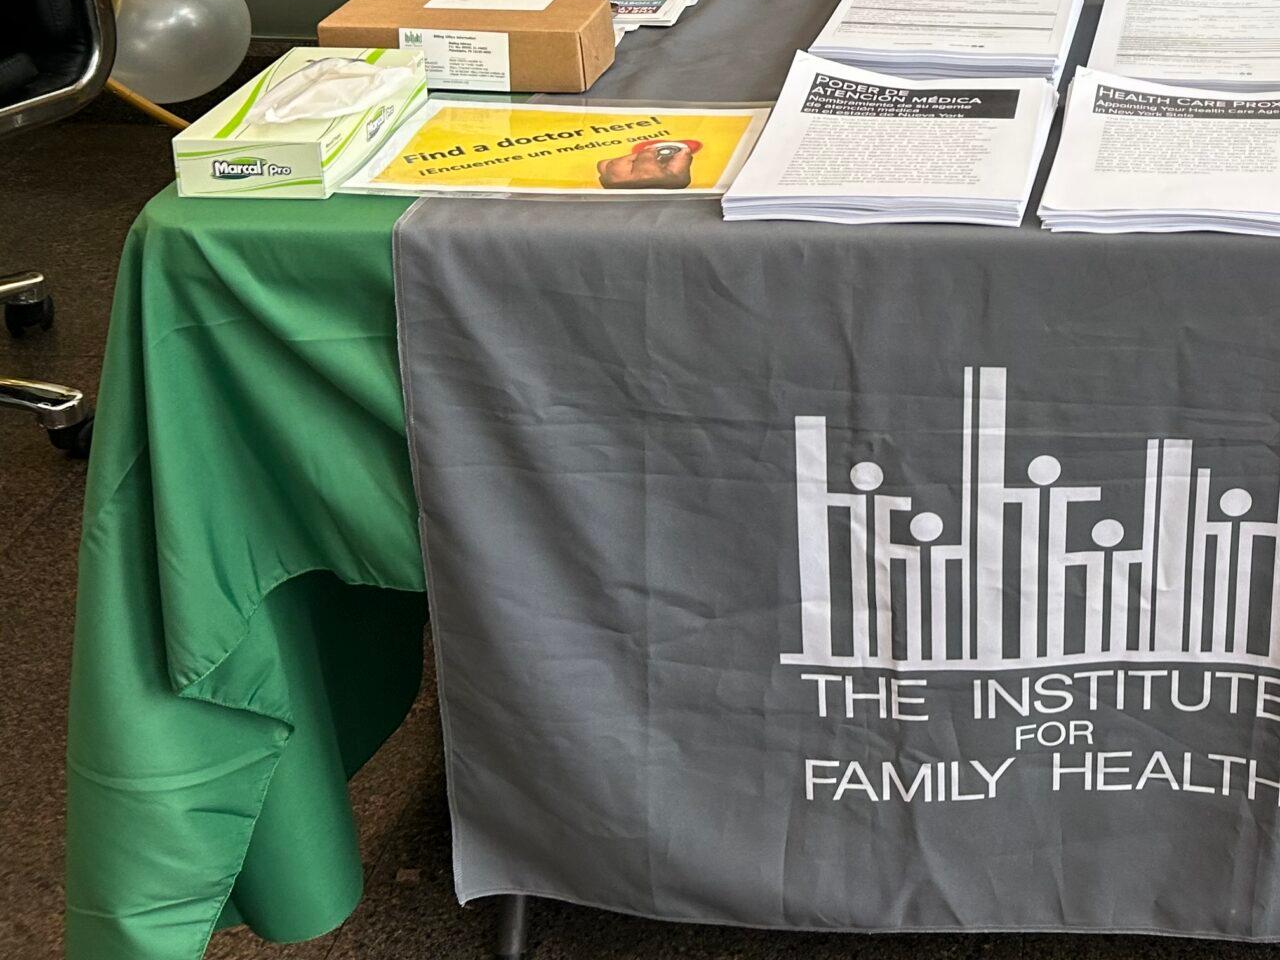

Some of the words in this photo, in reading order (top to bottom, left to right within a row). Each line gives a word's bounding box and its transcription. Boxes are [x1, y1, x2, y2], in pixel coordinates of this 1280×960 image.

[816, 75, 880, 94] PODER
[885, 88, 910, 96] DE
[808, 94, 894, 108] Nombramiento
[912, 96, 982, 104] MÉDICA
[1096, 99, 1158, 112] Appointing
[1188, 106, 1225, 114] Health
[1098, 86, 1170, 104] HEALTH
[1176, 98, 1226, 108] CARE
[1108, 108, 1134, 116] New
[402, 146, 466, 164] Find
[474, 144, 489, 154] a
[496, 128, 586, 148] doctor
[590, 116, 662, 135] here!
[418, 153, 524, 176] ¡Encuentre
[528, 148, 553, 159] un
[556, 138, 622, 155] médico
[213, 160, 264, 176] Marcal
[268, 164, 292, 176] Pro
[800, 672, 929, 721] THE
[1015, 720, 1094, 750] FOR
[805, 757, 1016, 803] FAMILY
